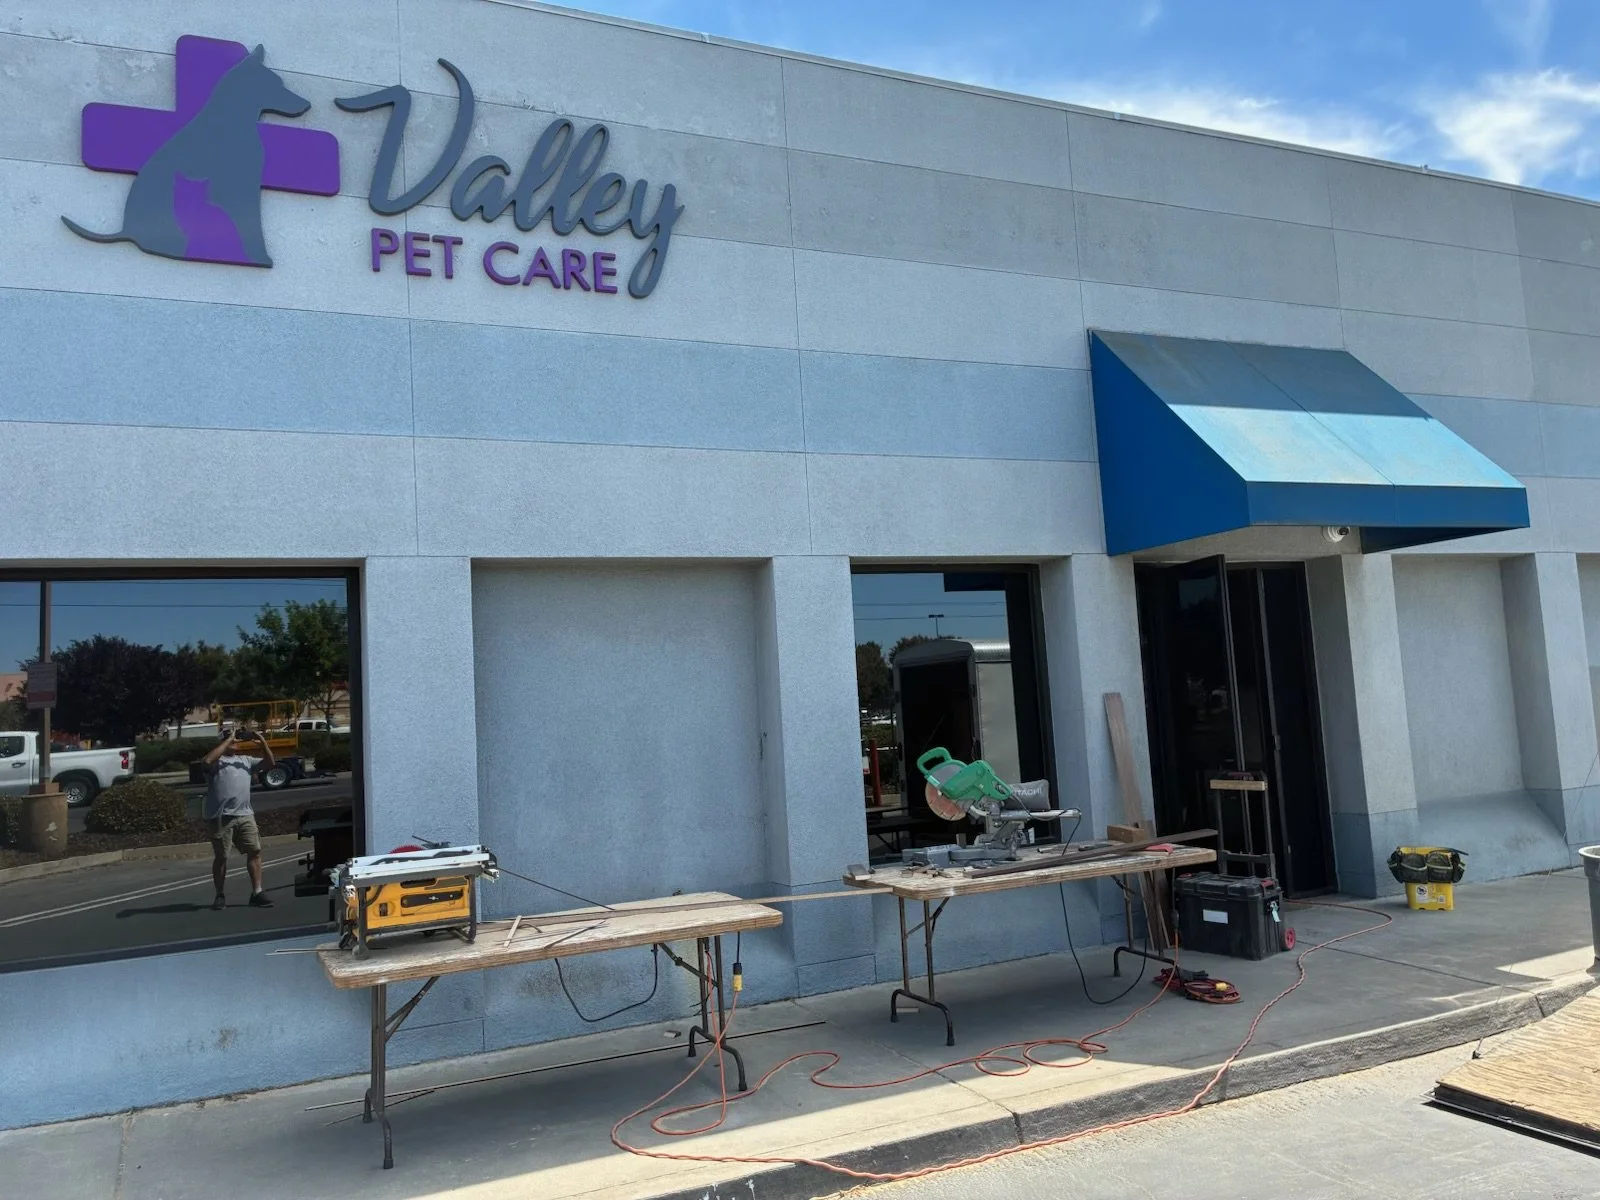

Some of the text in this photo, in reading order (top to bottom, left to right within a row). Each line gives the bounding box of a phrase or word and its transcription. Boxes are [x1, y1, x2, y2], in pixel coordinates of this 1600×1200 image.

[335, 58, 685, 299] Valley
[371, 228, 618, 294] PET CARE
[1013, 787, 1043, 797] TACHI
